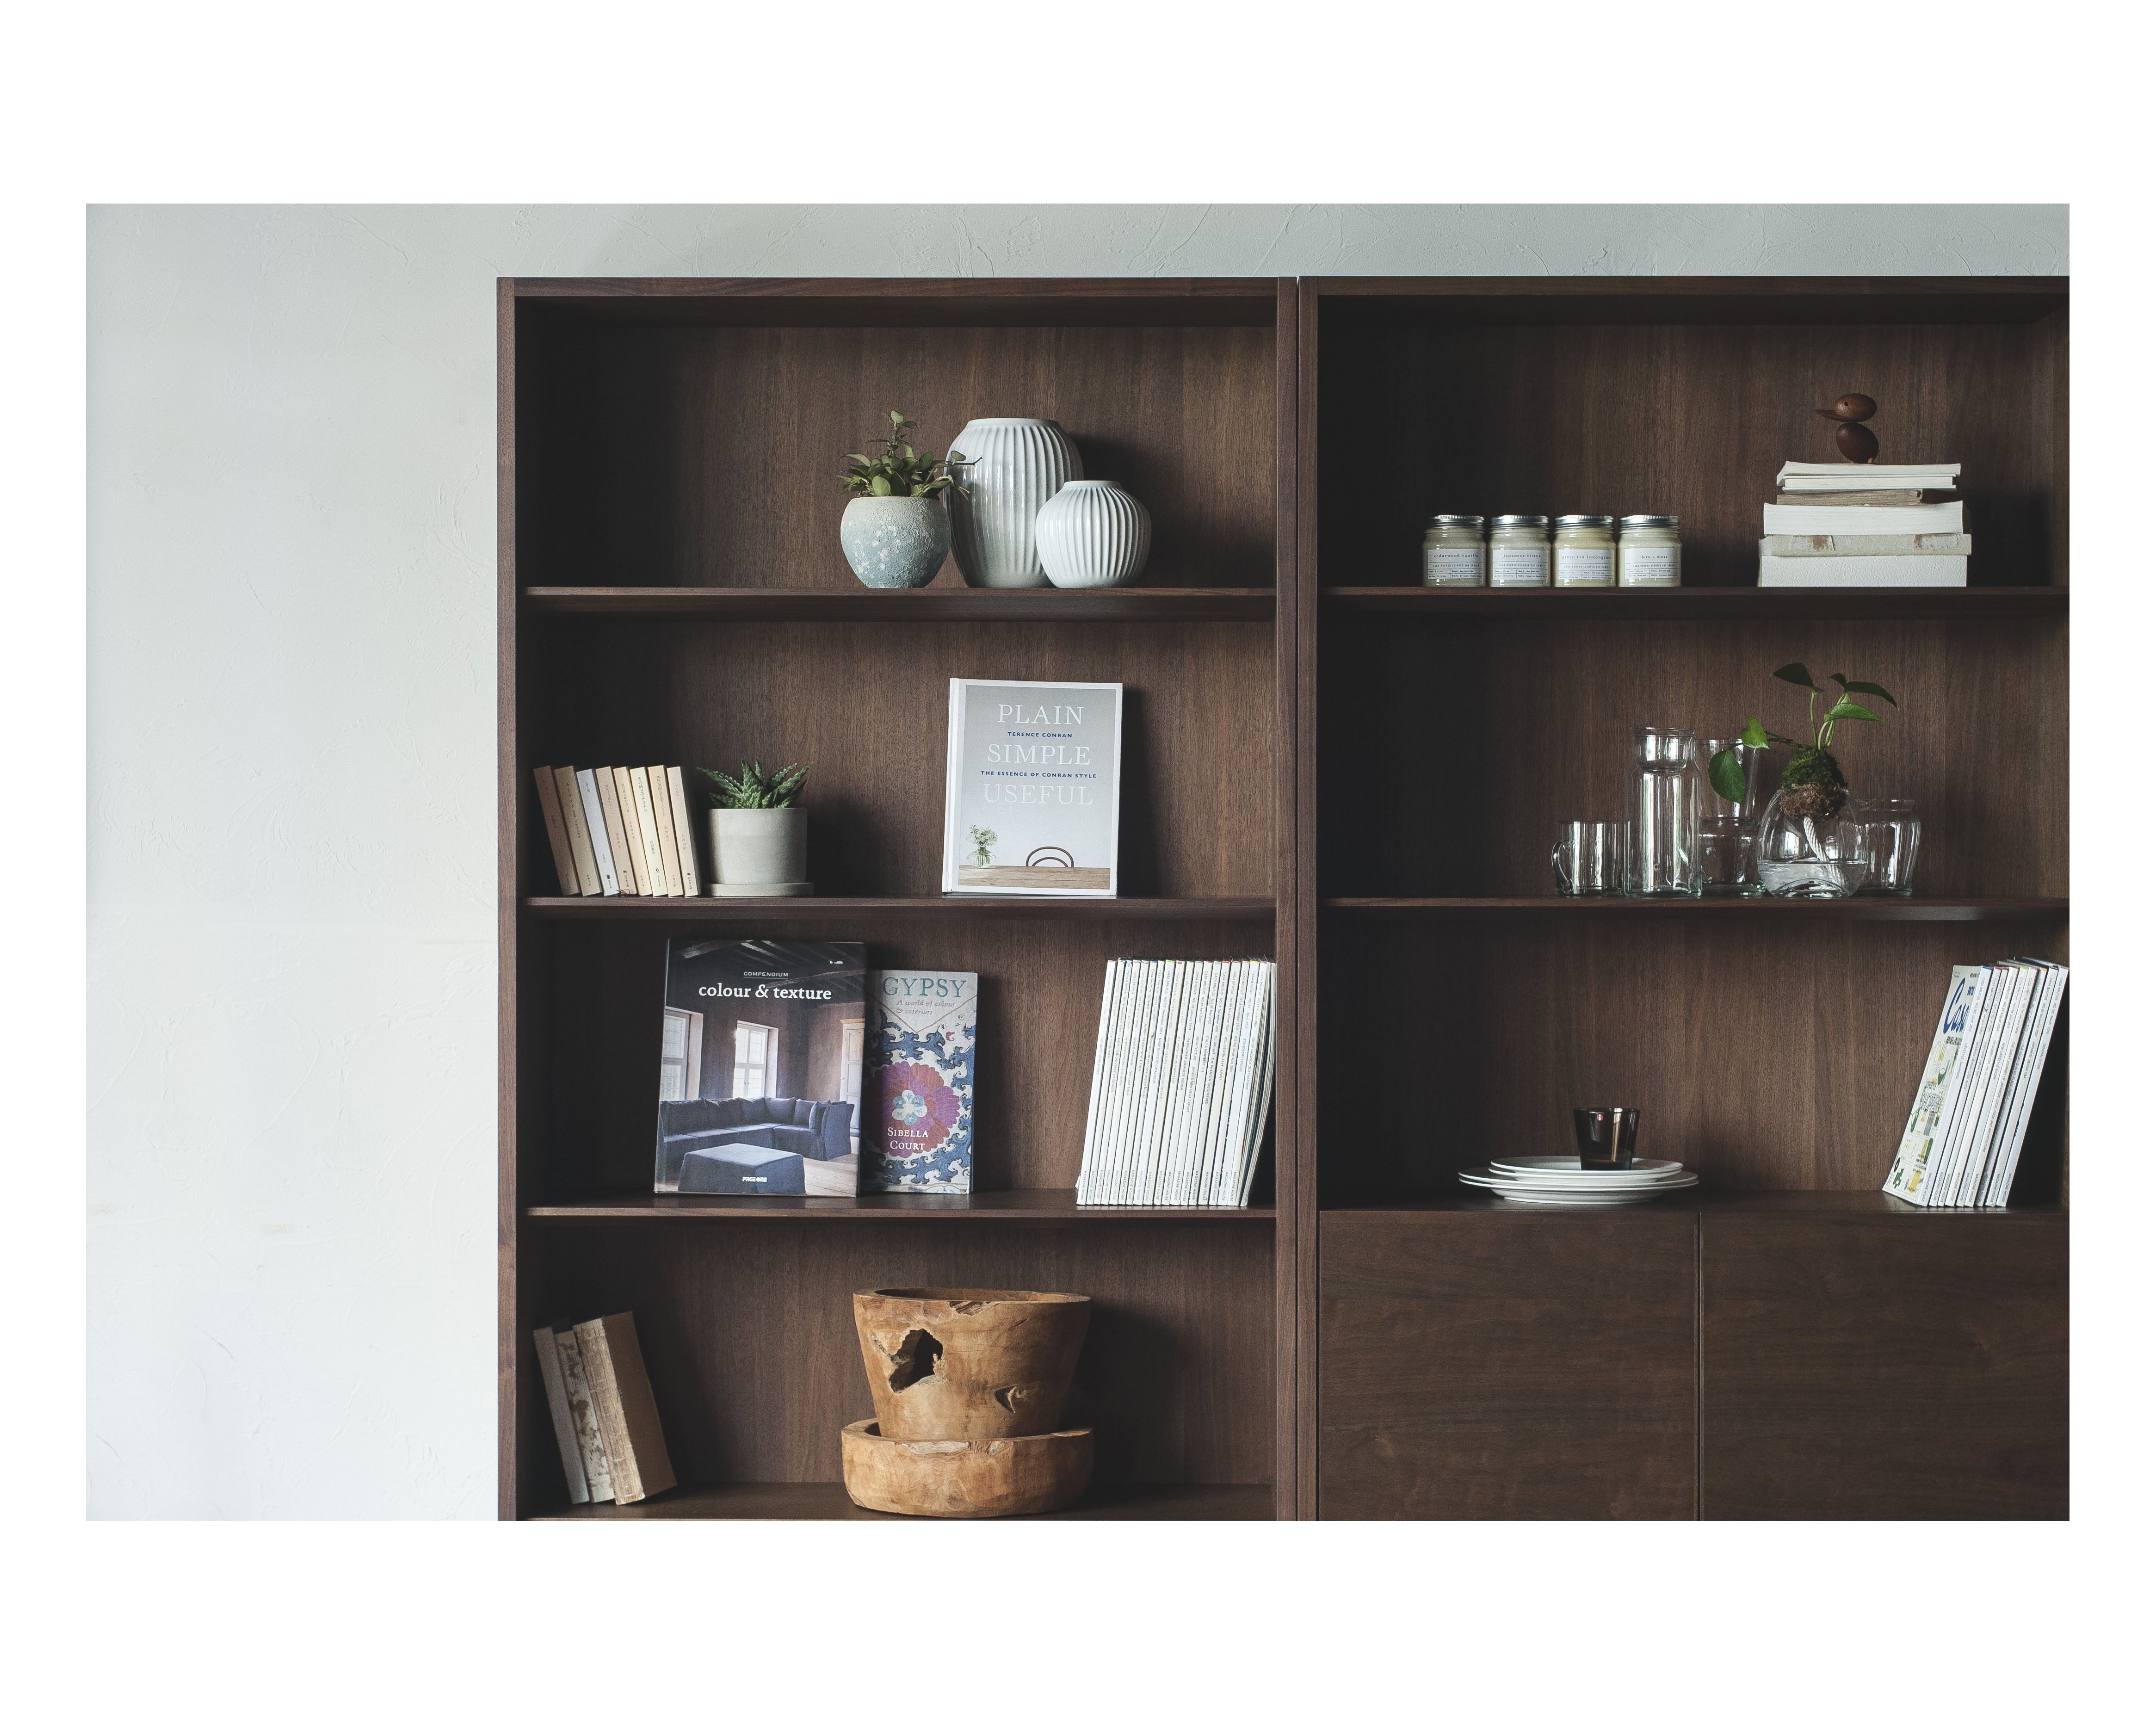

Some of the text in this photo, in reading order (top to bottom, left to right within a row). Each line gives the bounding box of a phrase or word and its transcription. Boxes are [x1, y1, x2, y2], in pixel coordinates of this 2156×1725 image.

[997, 704, 1084, 725] PLAIN
[988, 743, 1091, 765] SIMPLE
[637, 776, 647, 813] その時までサヨナラ
[983, 783, 1093, 805] USEFUL
[698, 983, 832, 1000] colour & texture
[883, 977, 967, 998] GYPSY
[1943, 977, 1970, 1034] Casa
[1983, 1127, 1991, 1152] ARCHITECTURE
